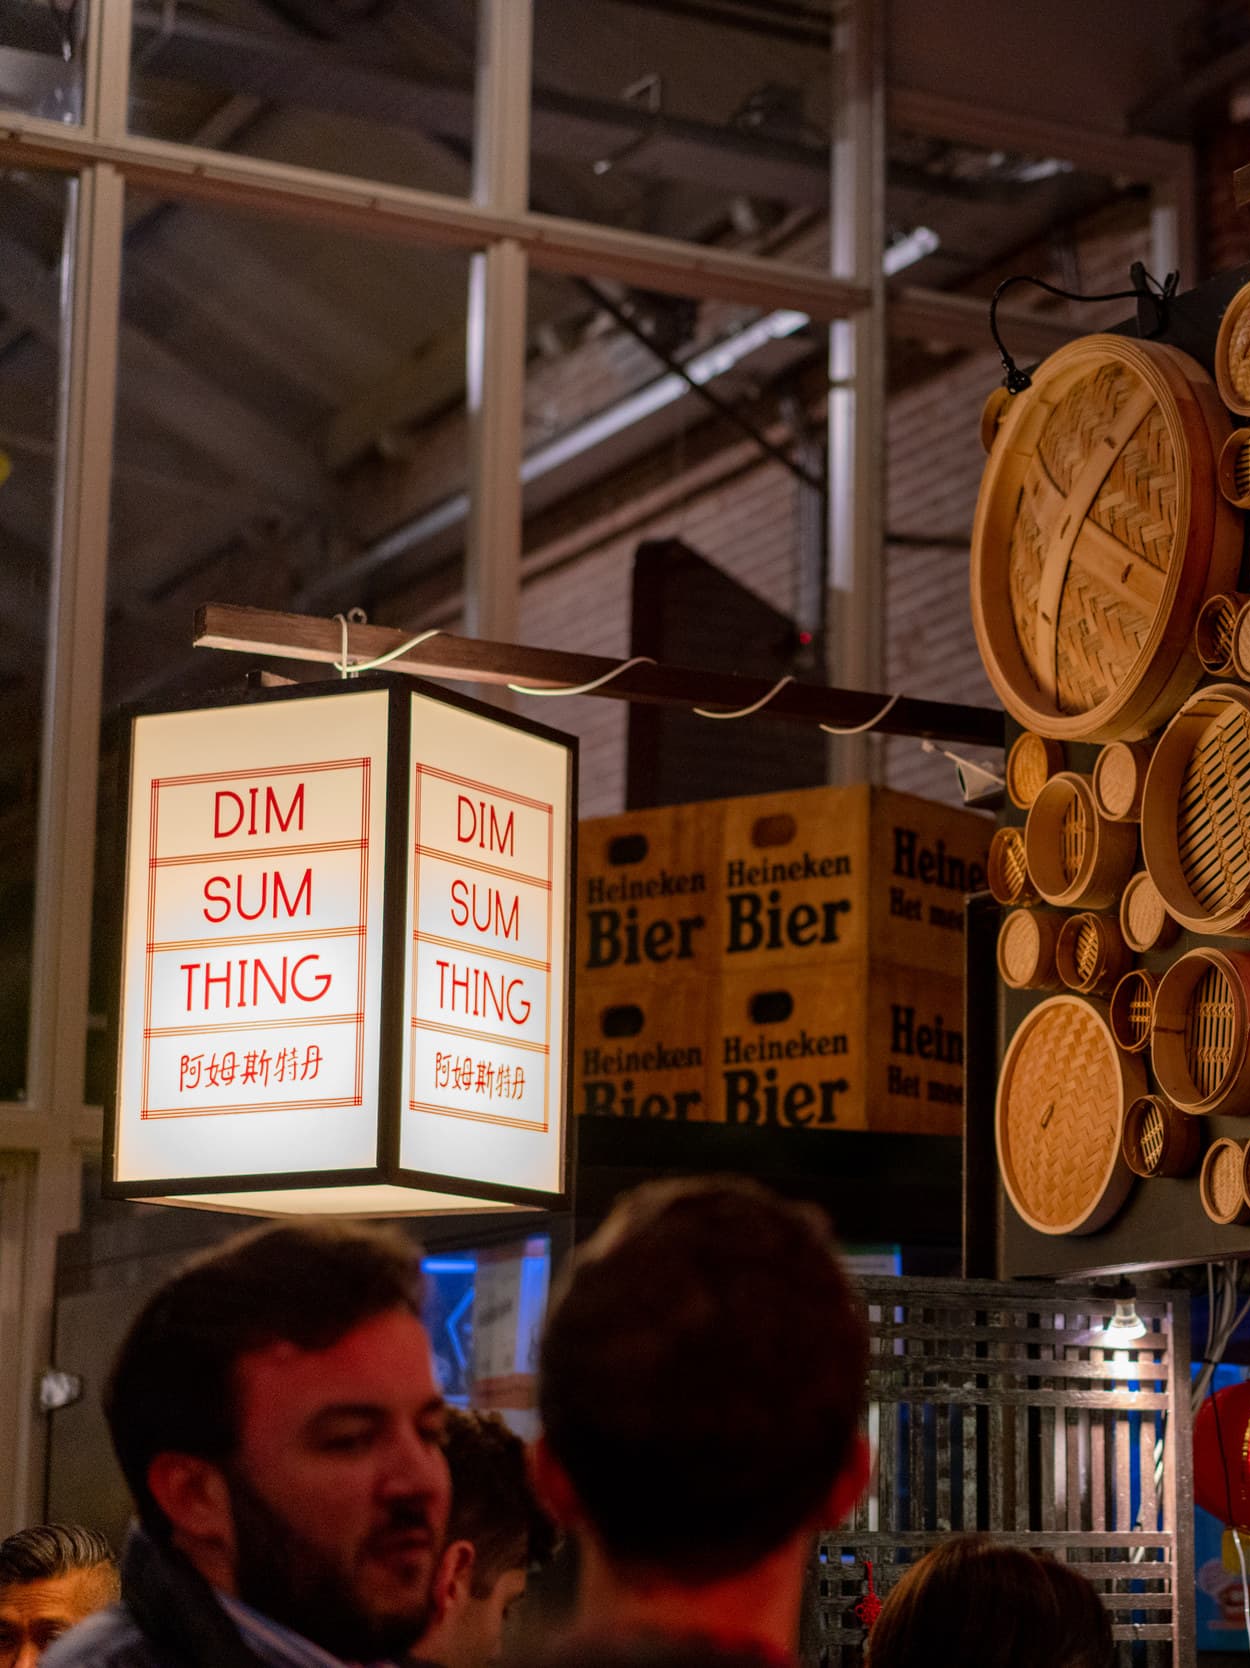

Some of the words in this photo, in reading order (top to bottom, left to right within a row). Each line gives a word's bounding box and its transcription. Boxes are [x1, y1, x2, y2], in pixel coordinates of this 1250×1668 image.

[214, 783, 305, 838] DIM
[457, 794, 515, 857] DIM
[203, 868, 312, 923] SUM
[587, 868, 706, 905] Heineken
[727, 852, 852, 889] Heineken
[450, 879, 520, 941] SUM
[585, 905, 706, 970] Bier
[726, 890, 852, 954] Bier
[180, 954, 332, 1012] THING
[435, 960, 531, 1026] THING
[179, 1044, 323, 1092] 阿姆斯特丹
[434, 1051, 526, 1100] 阿姆斯特丹
[582, 1042, 703, 1076] Heineken
[723, 1031, 849, 1066] Heineken
[723, 1067, 849, 1127] Bier
